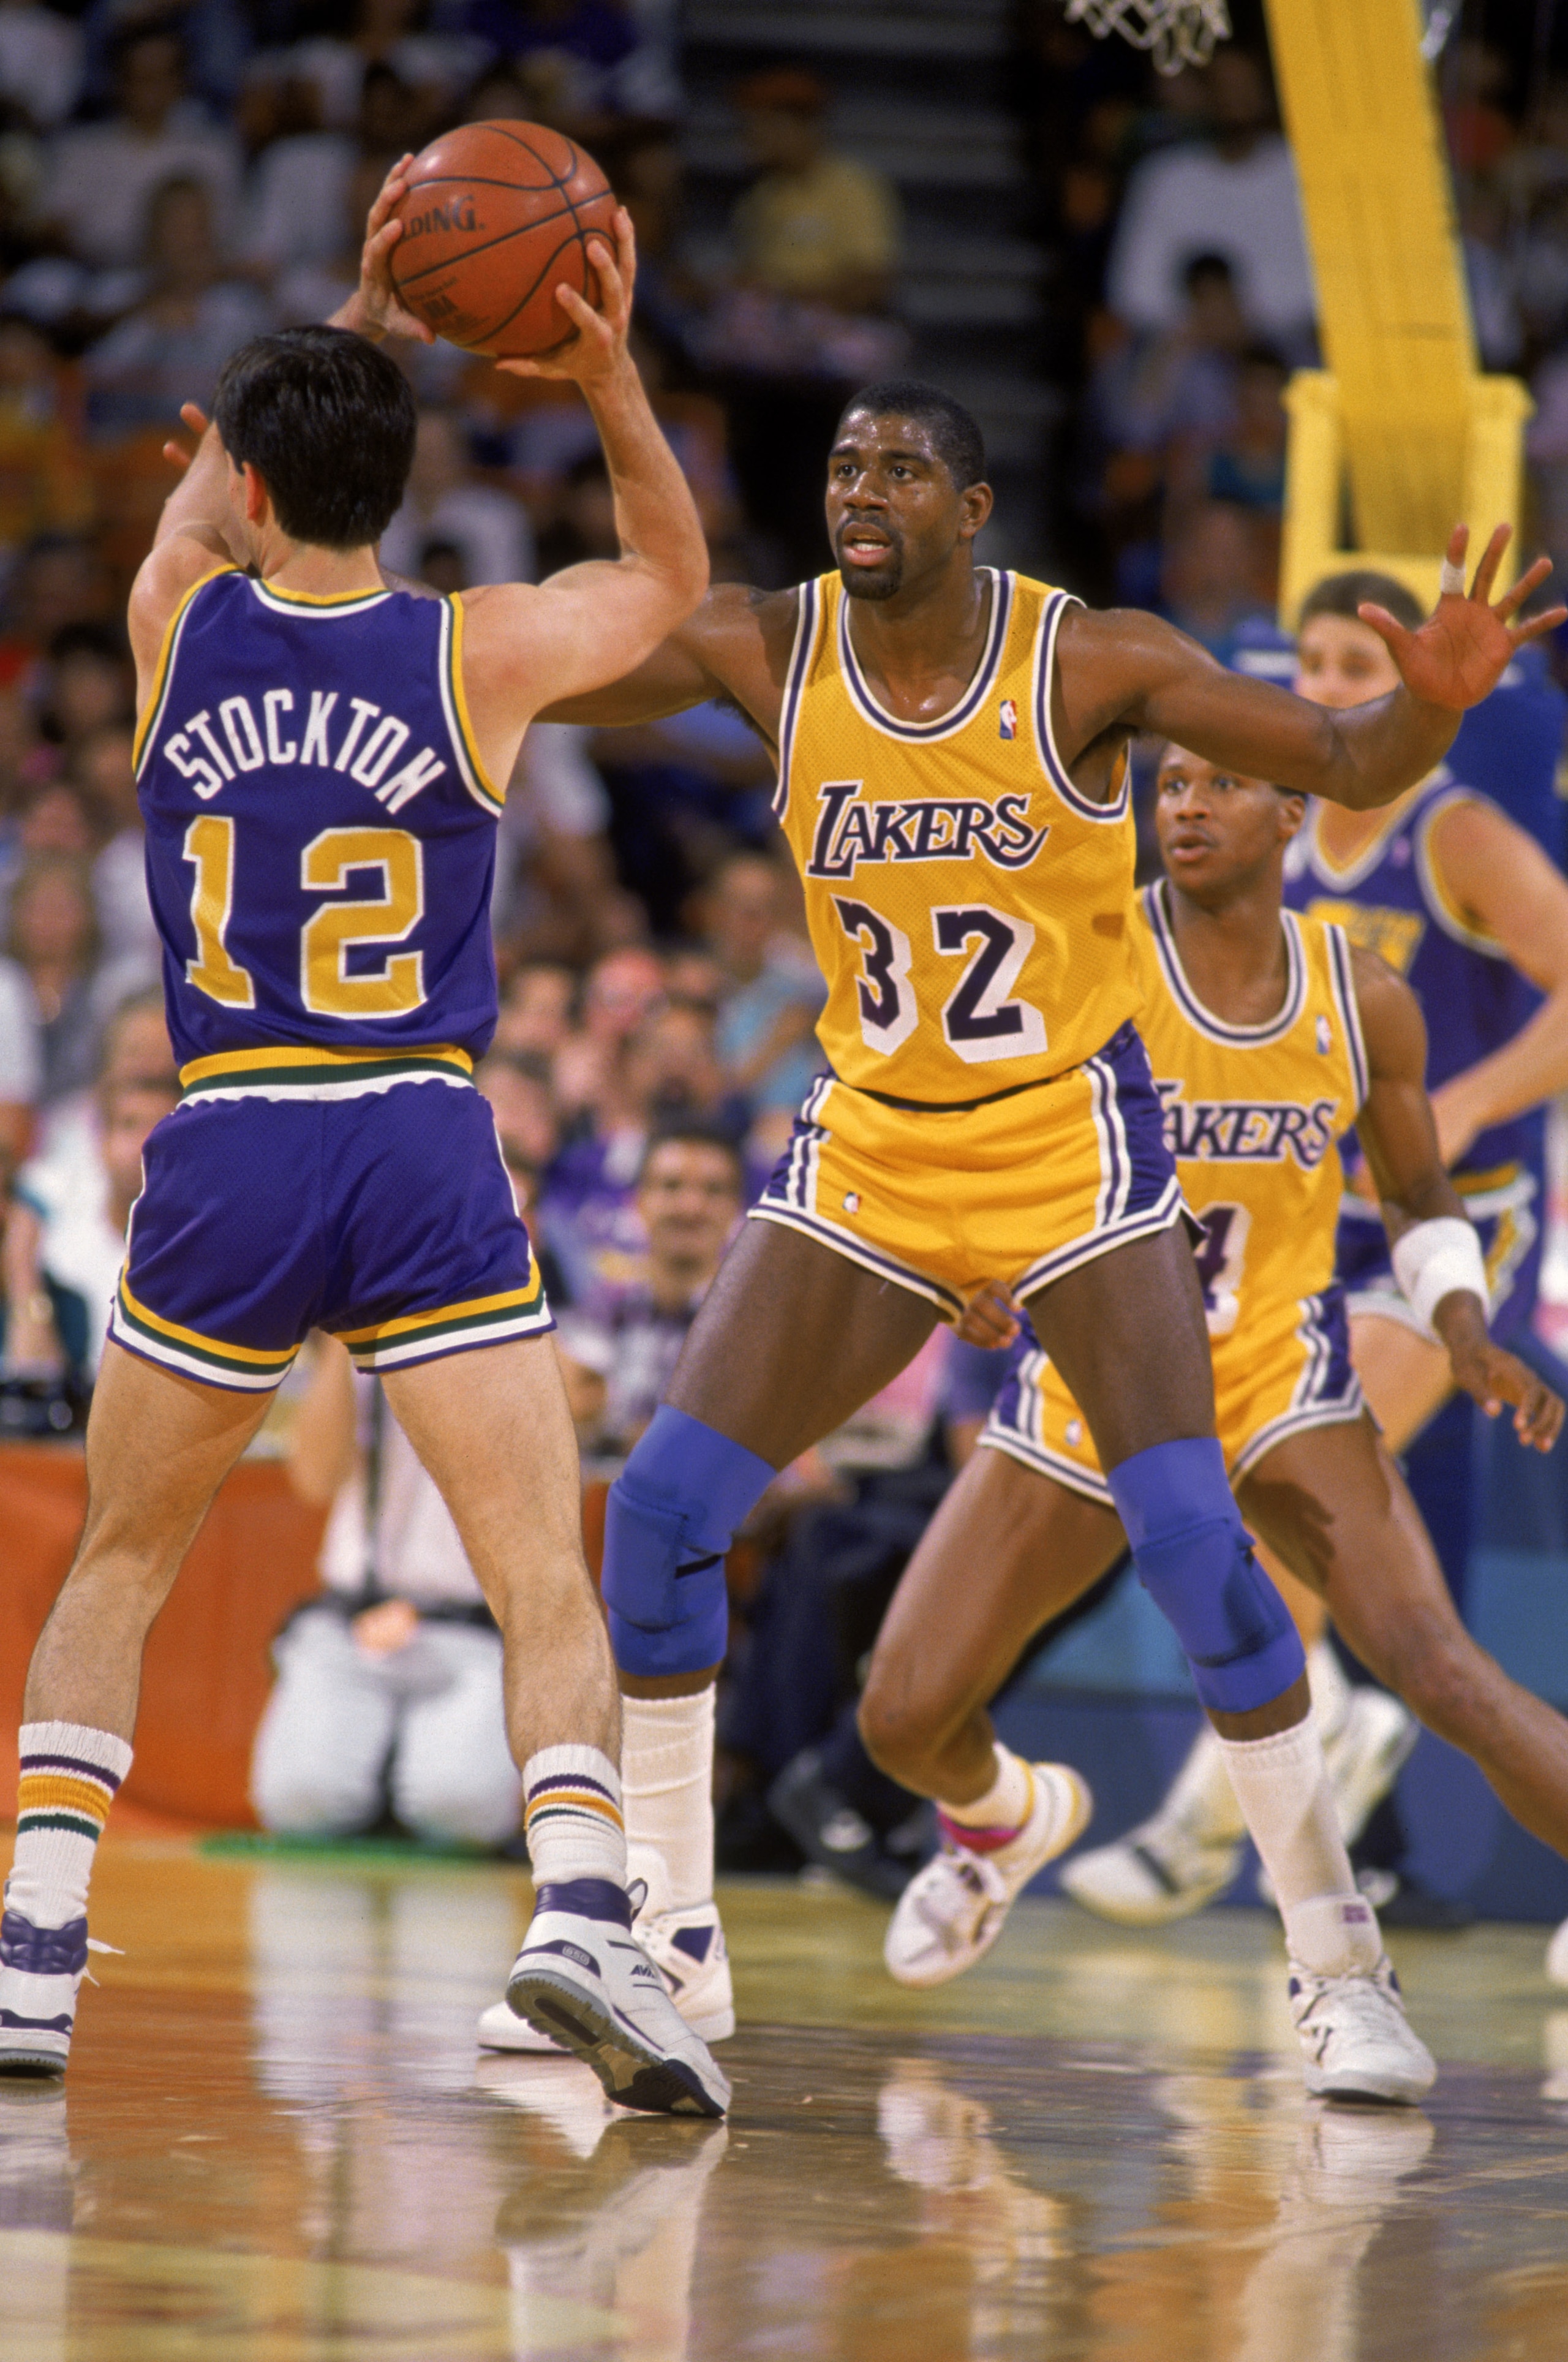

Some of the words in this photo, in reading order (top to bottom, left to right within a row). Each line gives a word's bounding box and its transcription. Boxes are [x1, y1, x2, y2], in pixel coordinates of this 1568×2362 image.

[164, 689, 447, 815] STOCKTON
[805, 779, 1050, 881] LAKERS
[183, 815, 428, 1020] 12
[829, 892, 1049, 1064] 32
